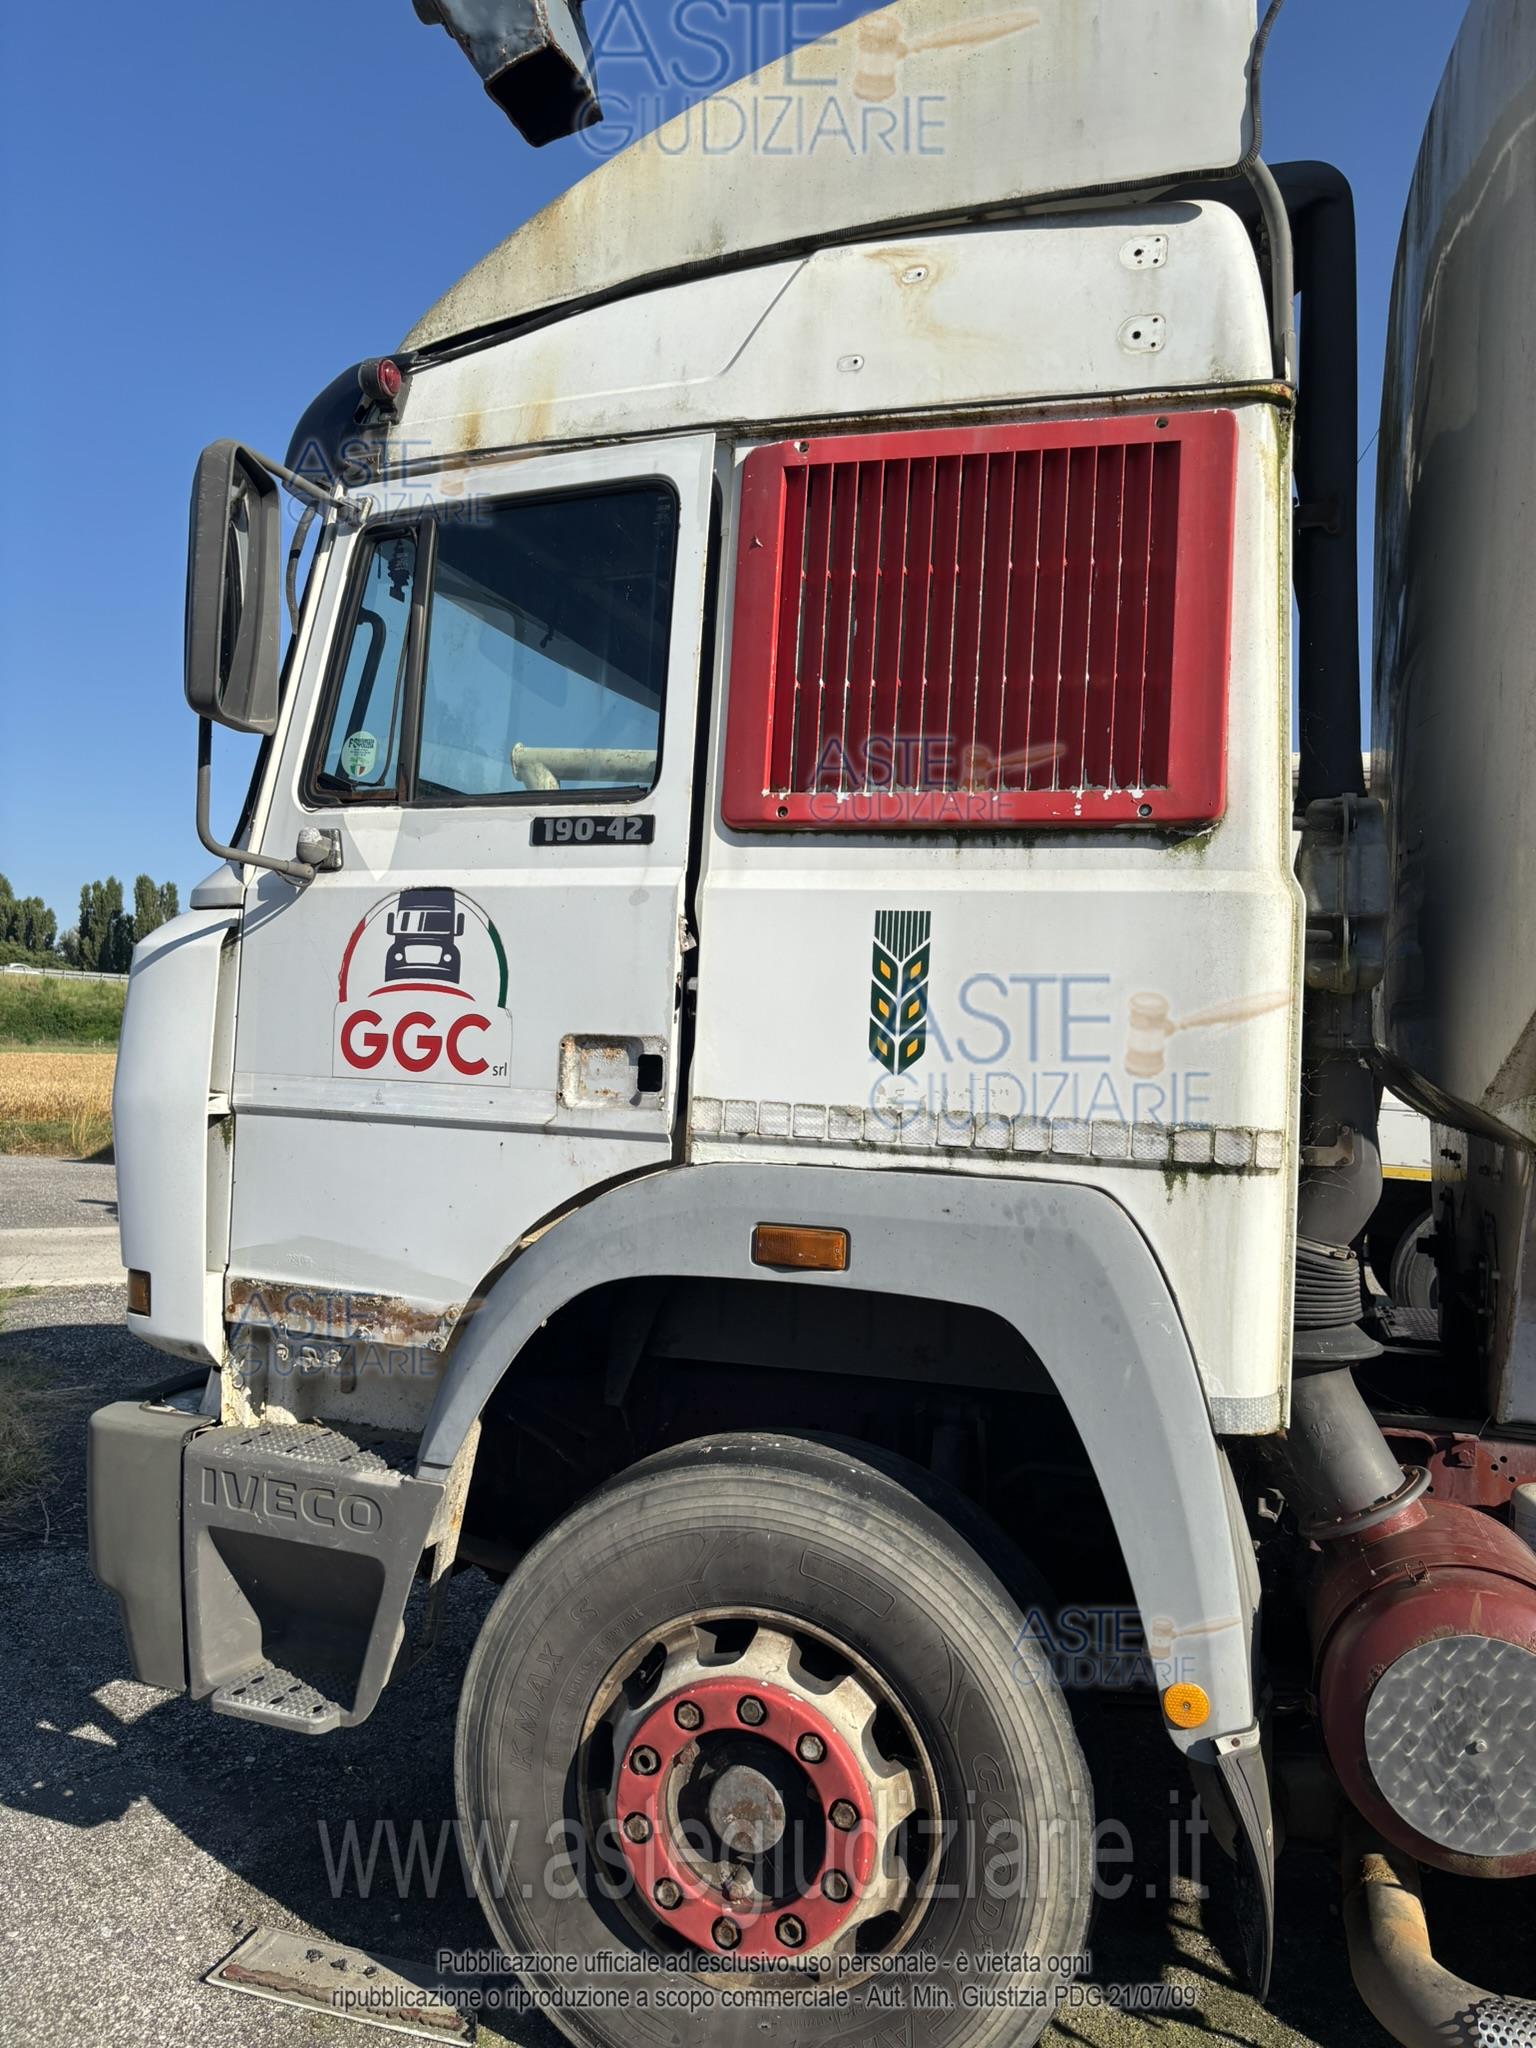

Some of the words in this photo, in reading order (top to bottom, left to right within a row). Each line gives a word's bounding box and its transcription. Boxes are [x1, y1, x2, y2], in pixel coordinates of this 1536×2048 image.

[543, 817, 643, 841] 190-42
[341, 1009, 492, 1076] GGC
[492, 1062, 508, 1077] srl
[201, 1466, 383, 1535] IVECO
